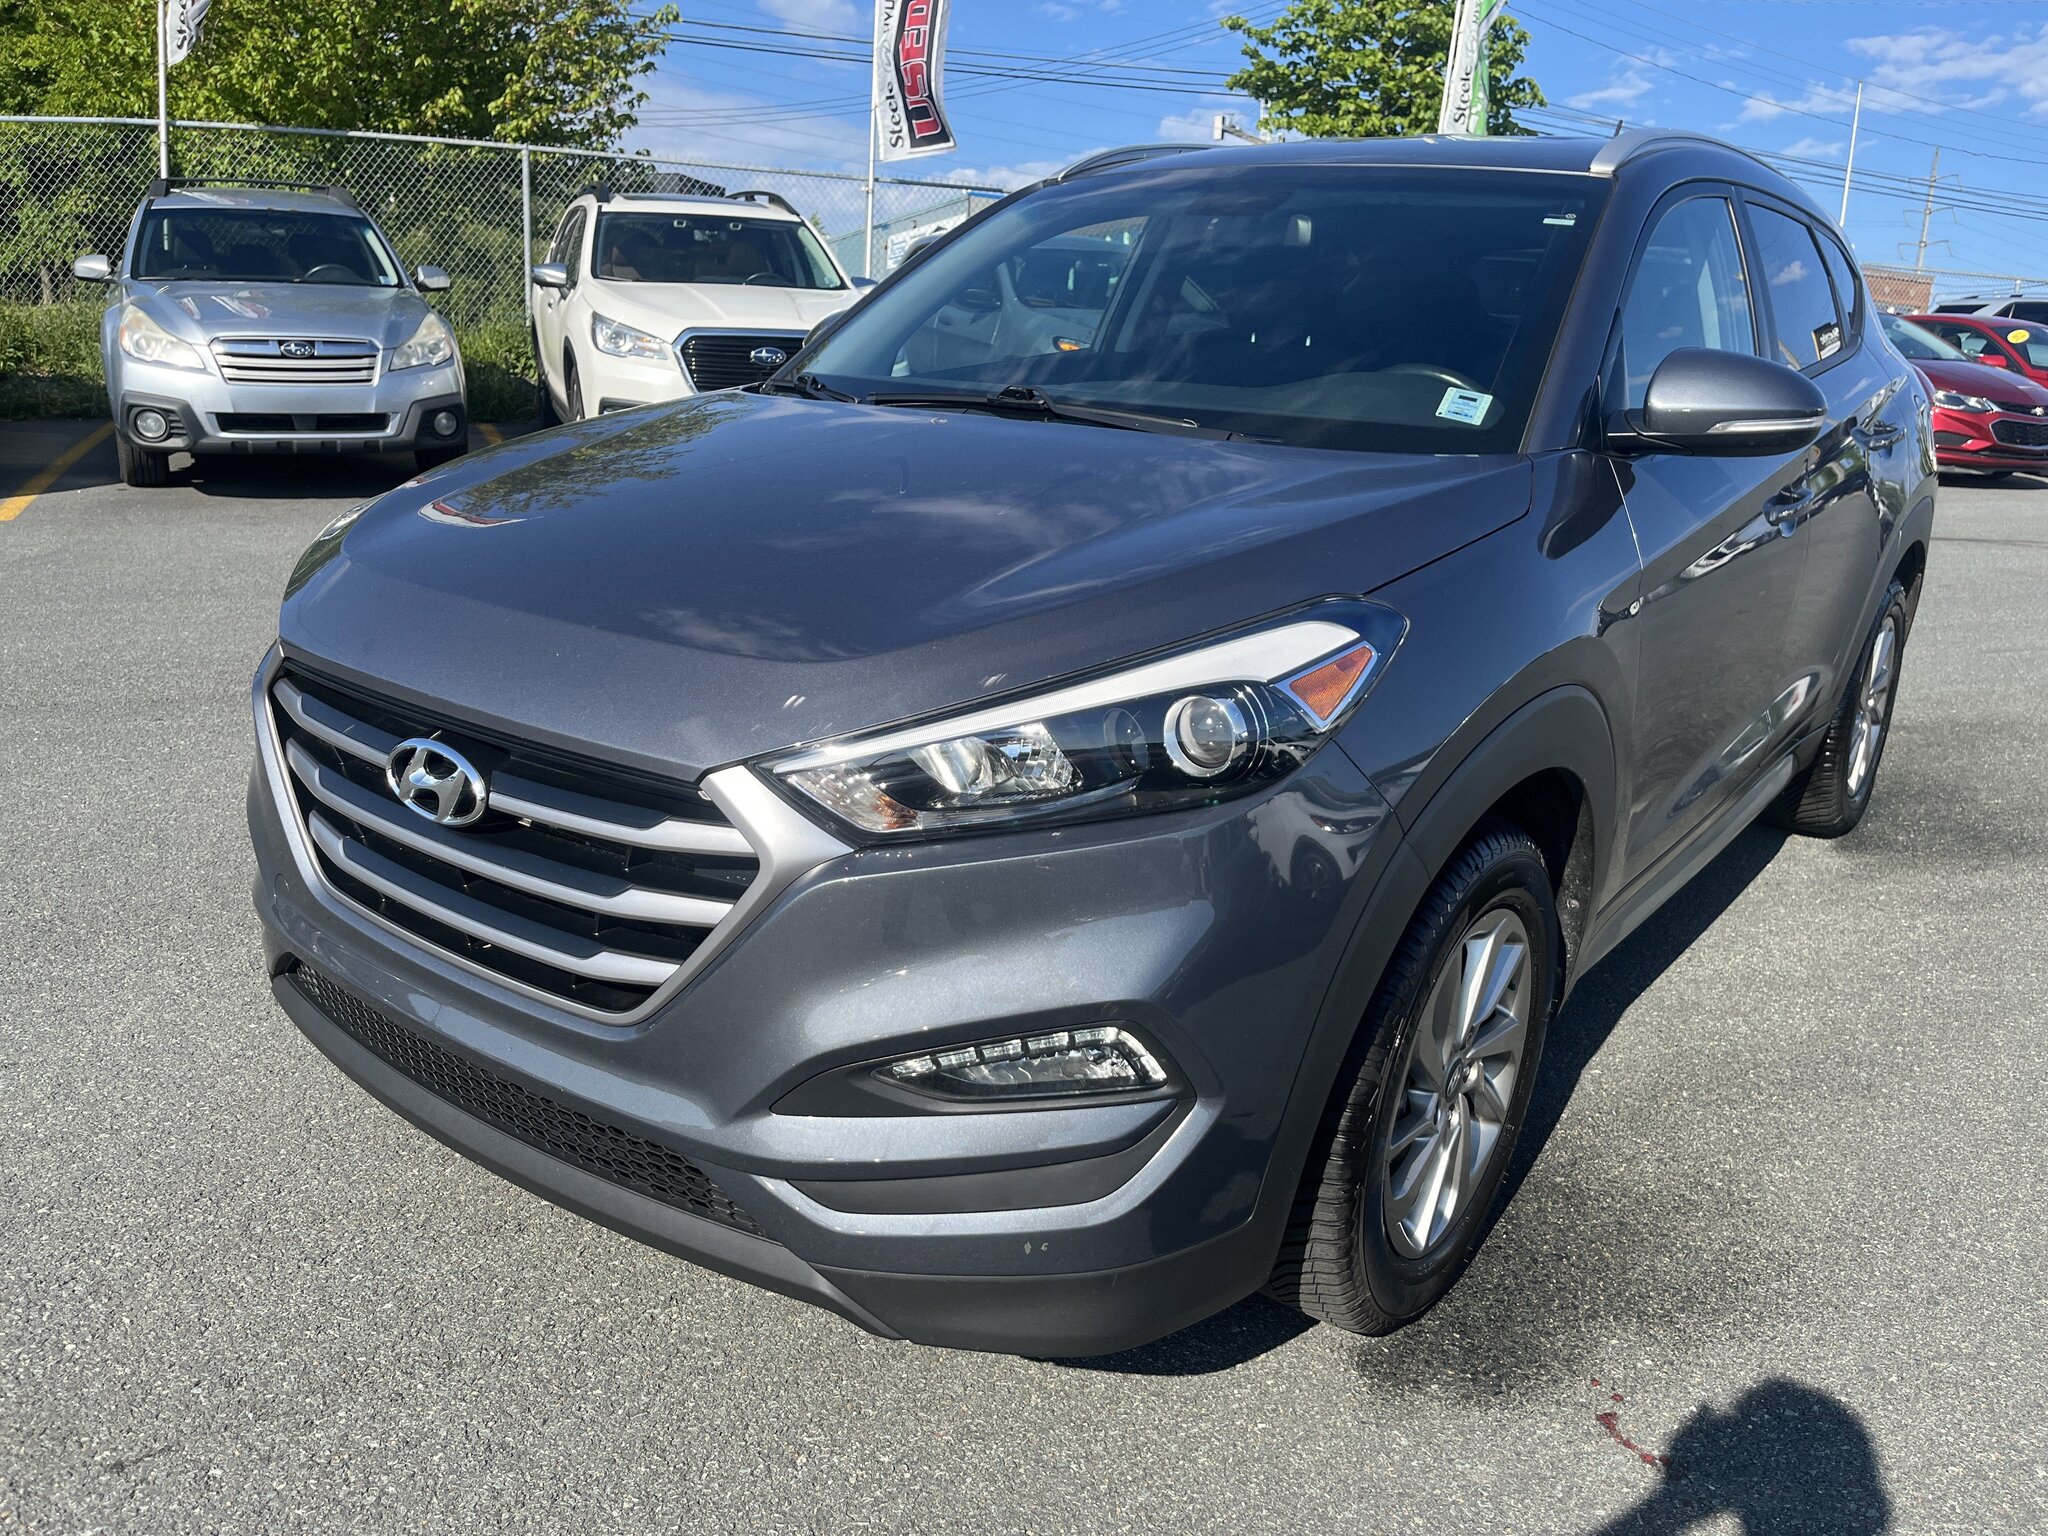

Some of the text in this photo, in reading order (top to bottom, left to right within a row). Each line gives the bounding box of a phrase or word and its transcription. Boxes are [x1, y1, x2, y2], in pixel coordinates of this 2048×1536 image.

[899, 0, 942, 139] USED
[1453, 65, 1473, 125] Steele
[886, 83, 904, 148] Steele
